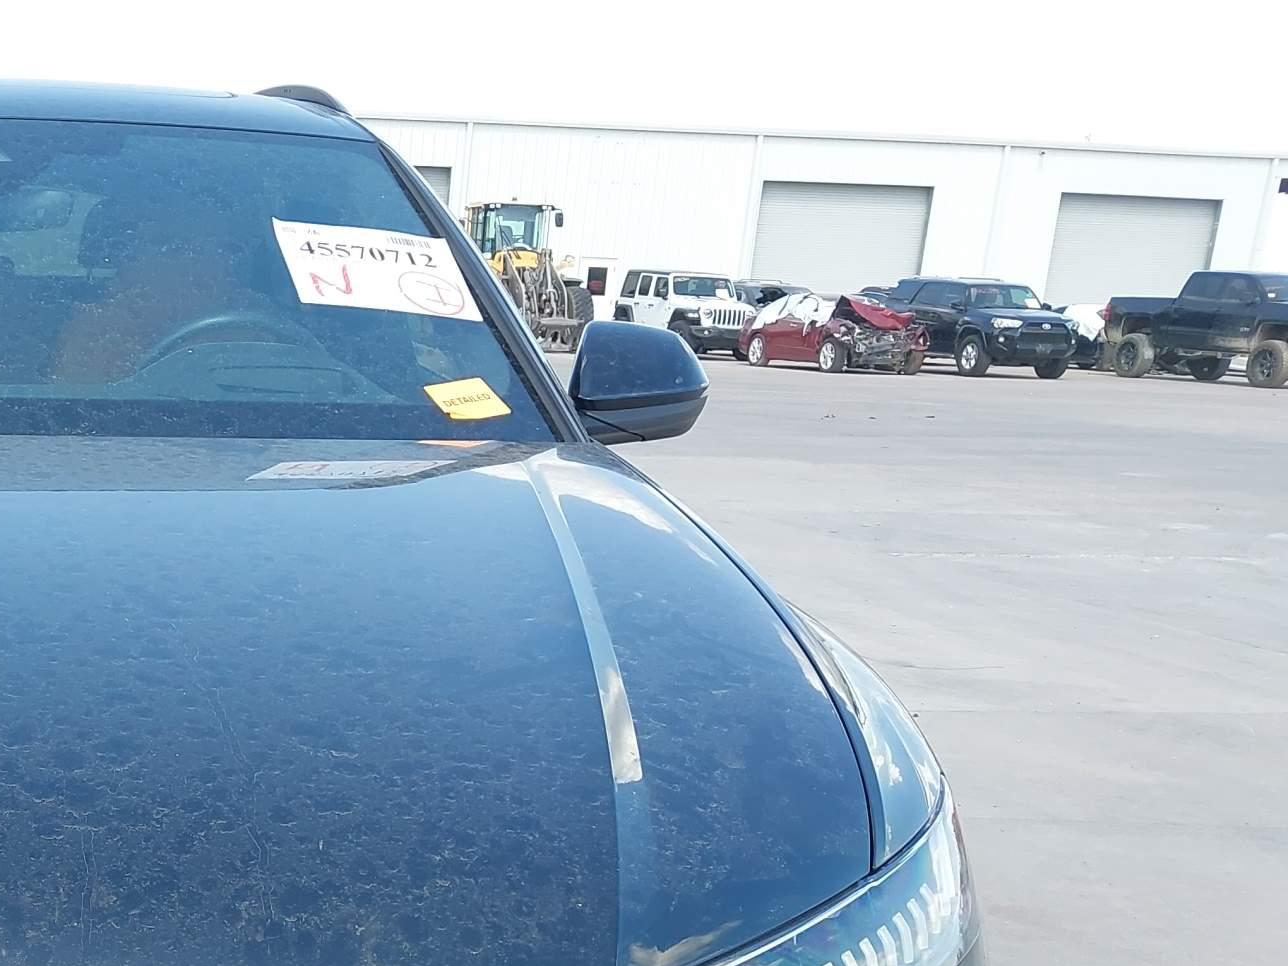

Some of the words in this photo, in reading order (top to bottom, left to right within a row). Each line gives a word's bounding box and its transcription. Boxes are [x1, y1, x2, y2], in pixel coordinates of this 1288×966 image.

[299, 241, 438, 269] 45570712
[309, 263, 353, 297] N
[442, 392, 492, 408] DETAILED
